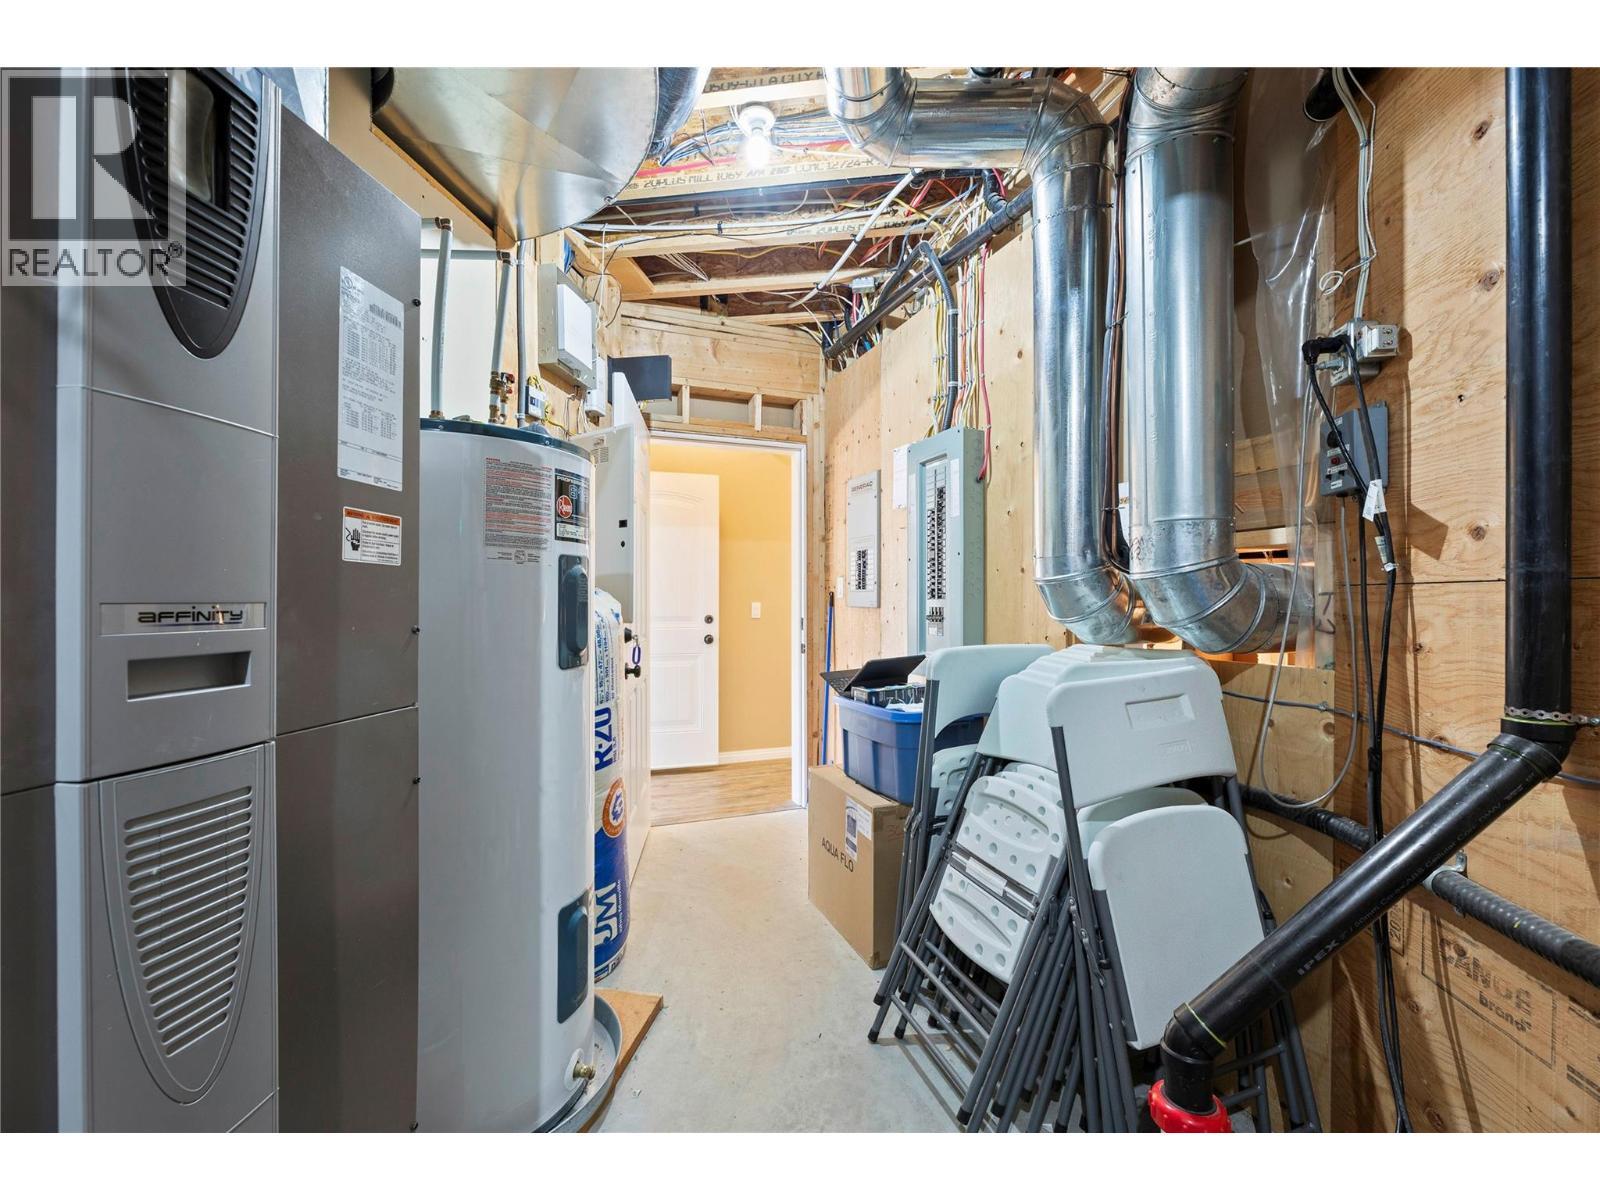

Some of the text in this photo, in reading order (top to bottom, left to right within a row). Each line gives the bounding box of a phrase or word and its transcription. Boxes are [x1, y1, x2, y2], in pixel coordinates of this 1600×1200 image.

[821, 837, 854, 873] AQUA FLO
[1295, 938, 1341, 976] IPEX
